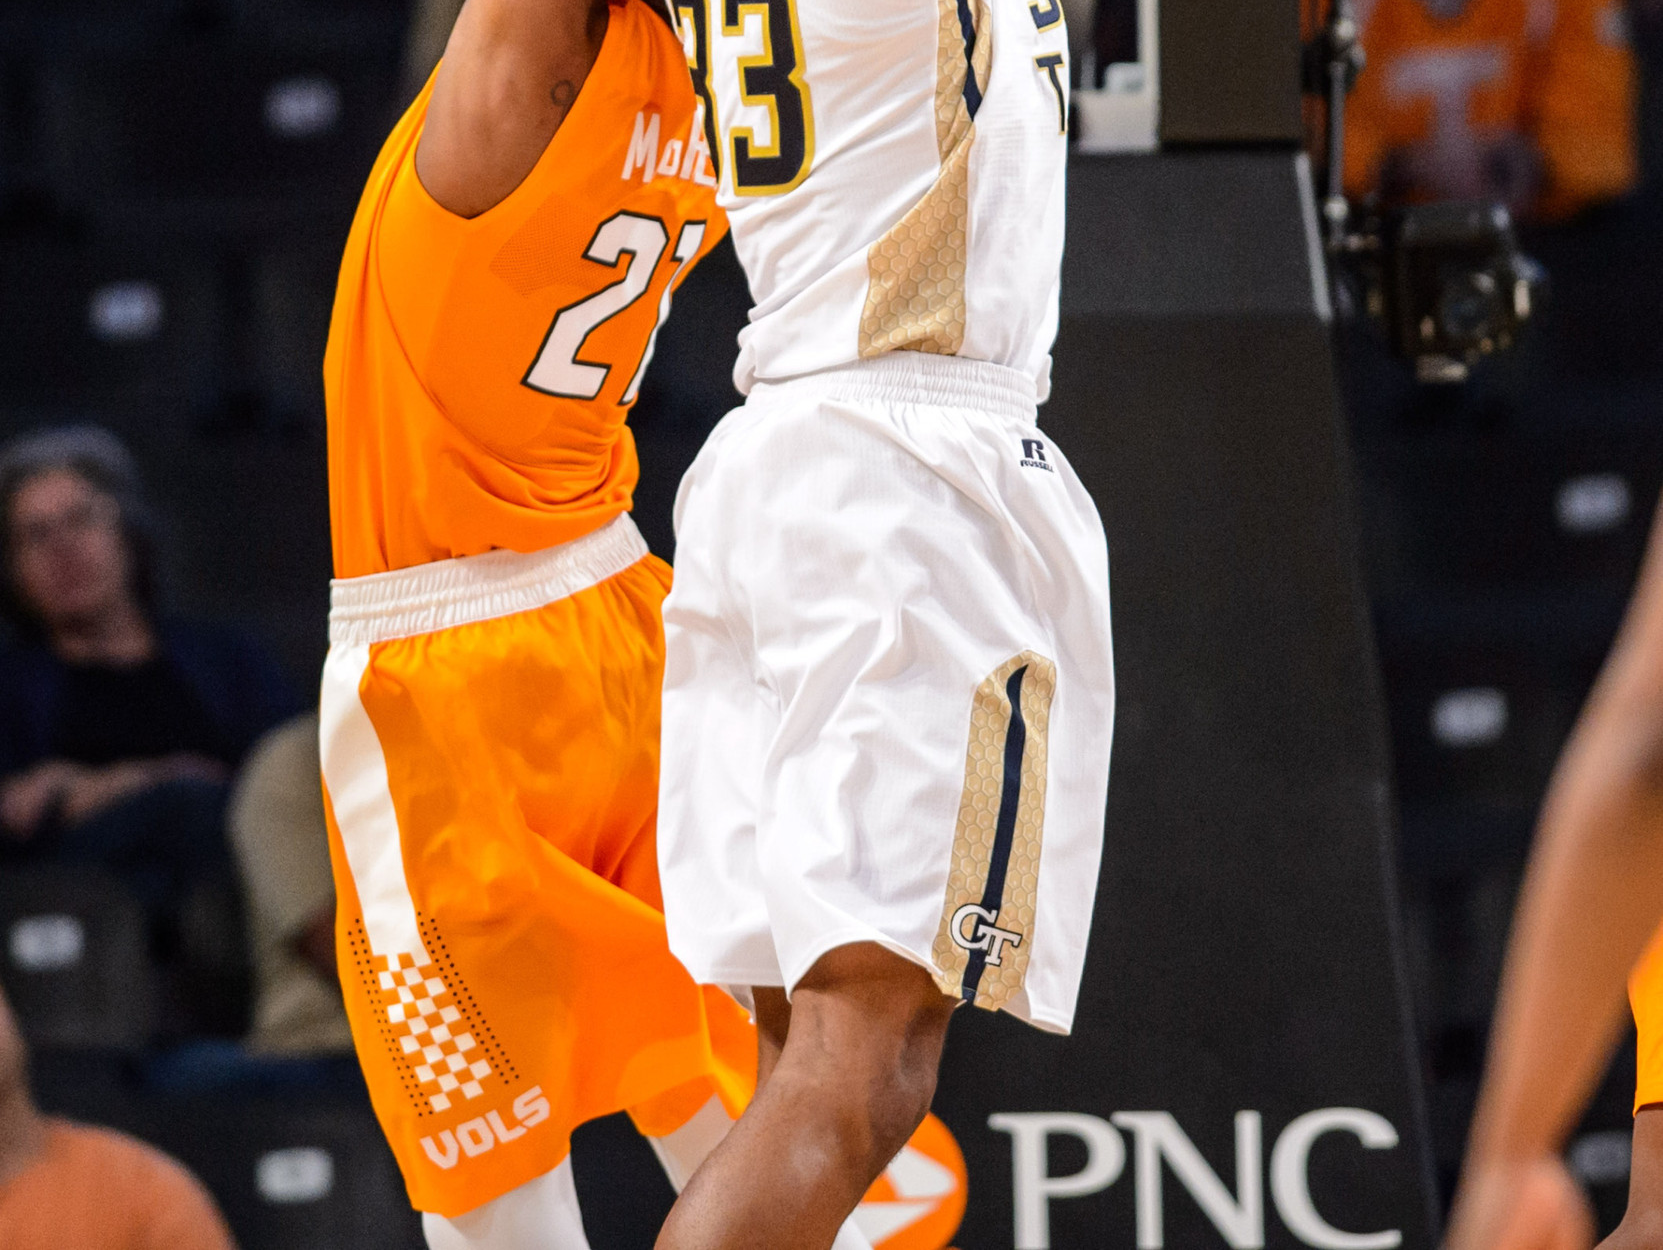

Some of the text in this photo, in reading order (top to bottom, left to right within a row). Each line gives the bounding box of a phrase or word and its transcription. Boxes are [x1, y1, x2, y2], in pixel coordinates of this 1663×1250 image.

[950, 902, 1023, 968] GT
[419, 1085, 551, 1170] VOLS
[987, 1106, 1402, 1250] PNC
